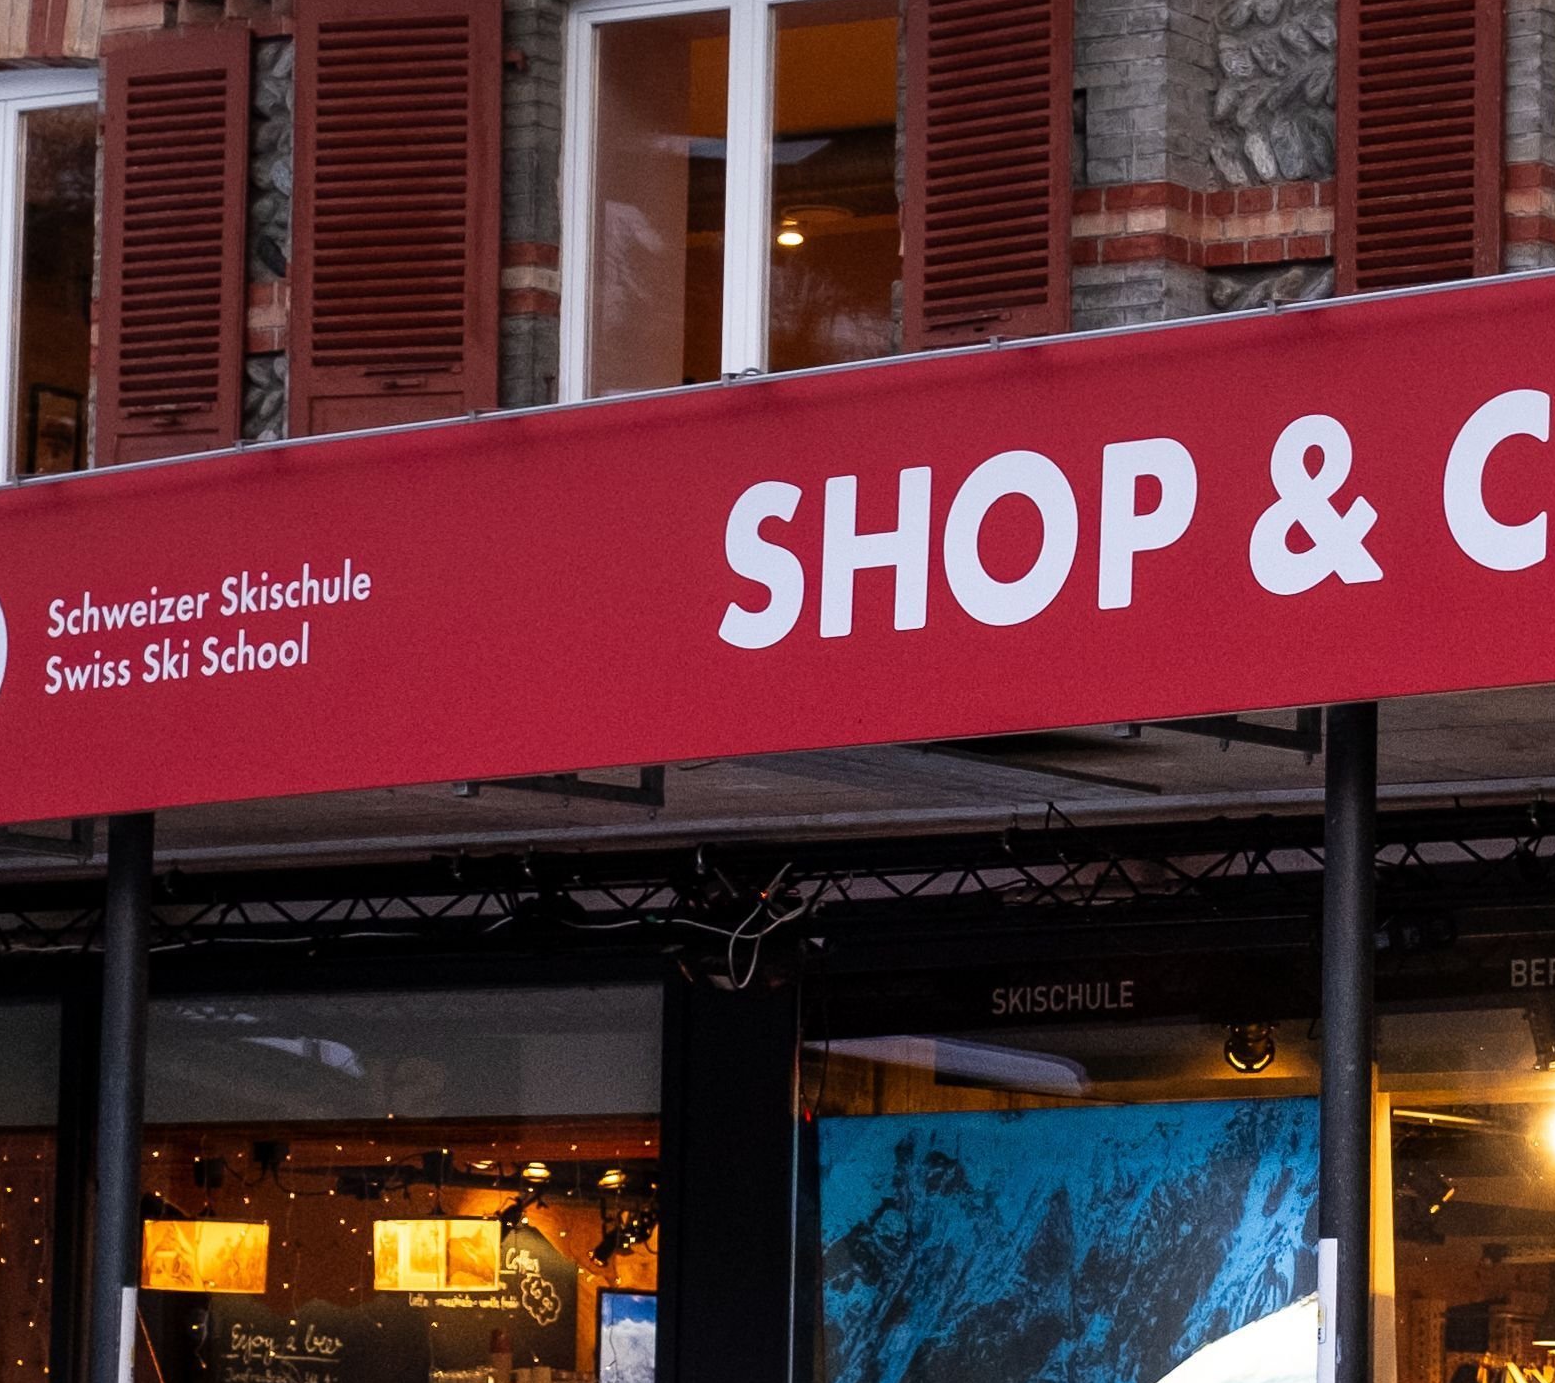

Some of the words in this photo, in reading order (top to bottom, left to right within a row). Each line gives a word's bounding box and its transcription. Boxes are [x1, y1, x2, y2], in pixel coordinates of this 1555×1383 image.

[717, 436, 1198, 649] SHOP
[1248, 414, 1384, 597] &
[47, 586, 210, 638] Schweizer
[220, 558, 372, 617] Skischule
[44, 650, 131, 695] Swiss
[142, 638, 190, 683] Ski
[201, 621, 310, 677] School
[991, 980, 1135, 1014] SKISCHULE
